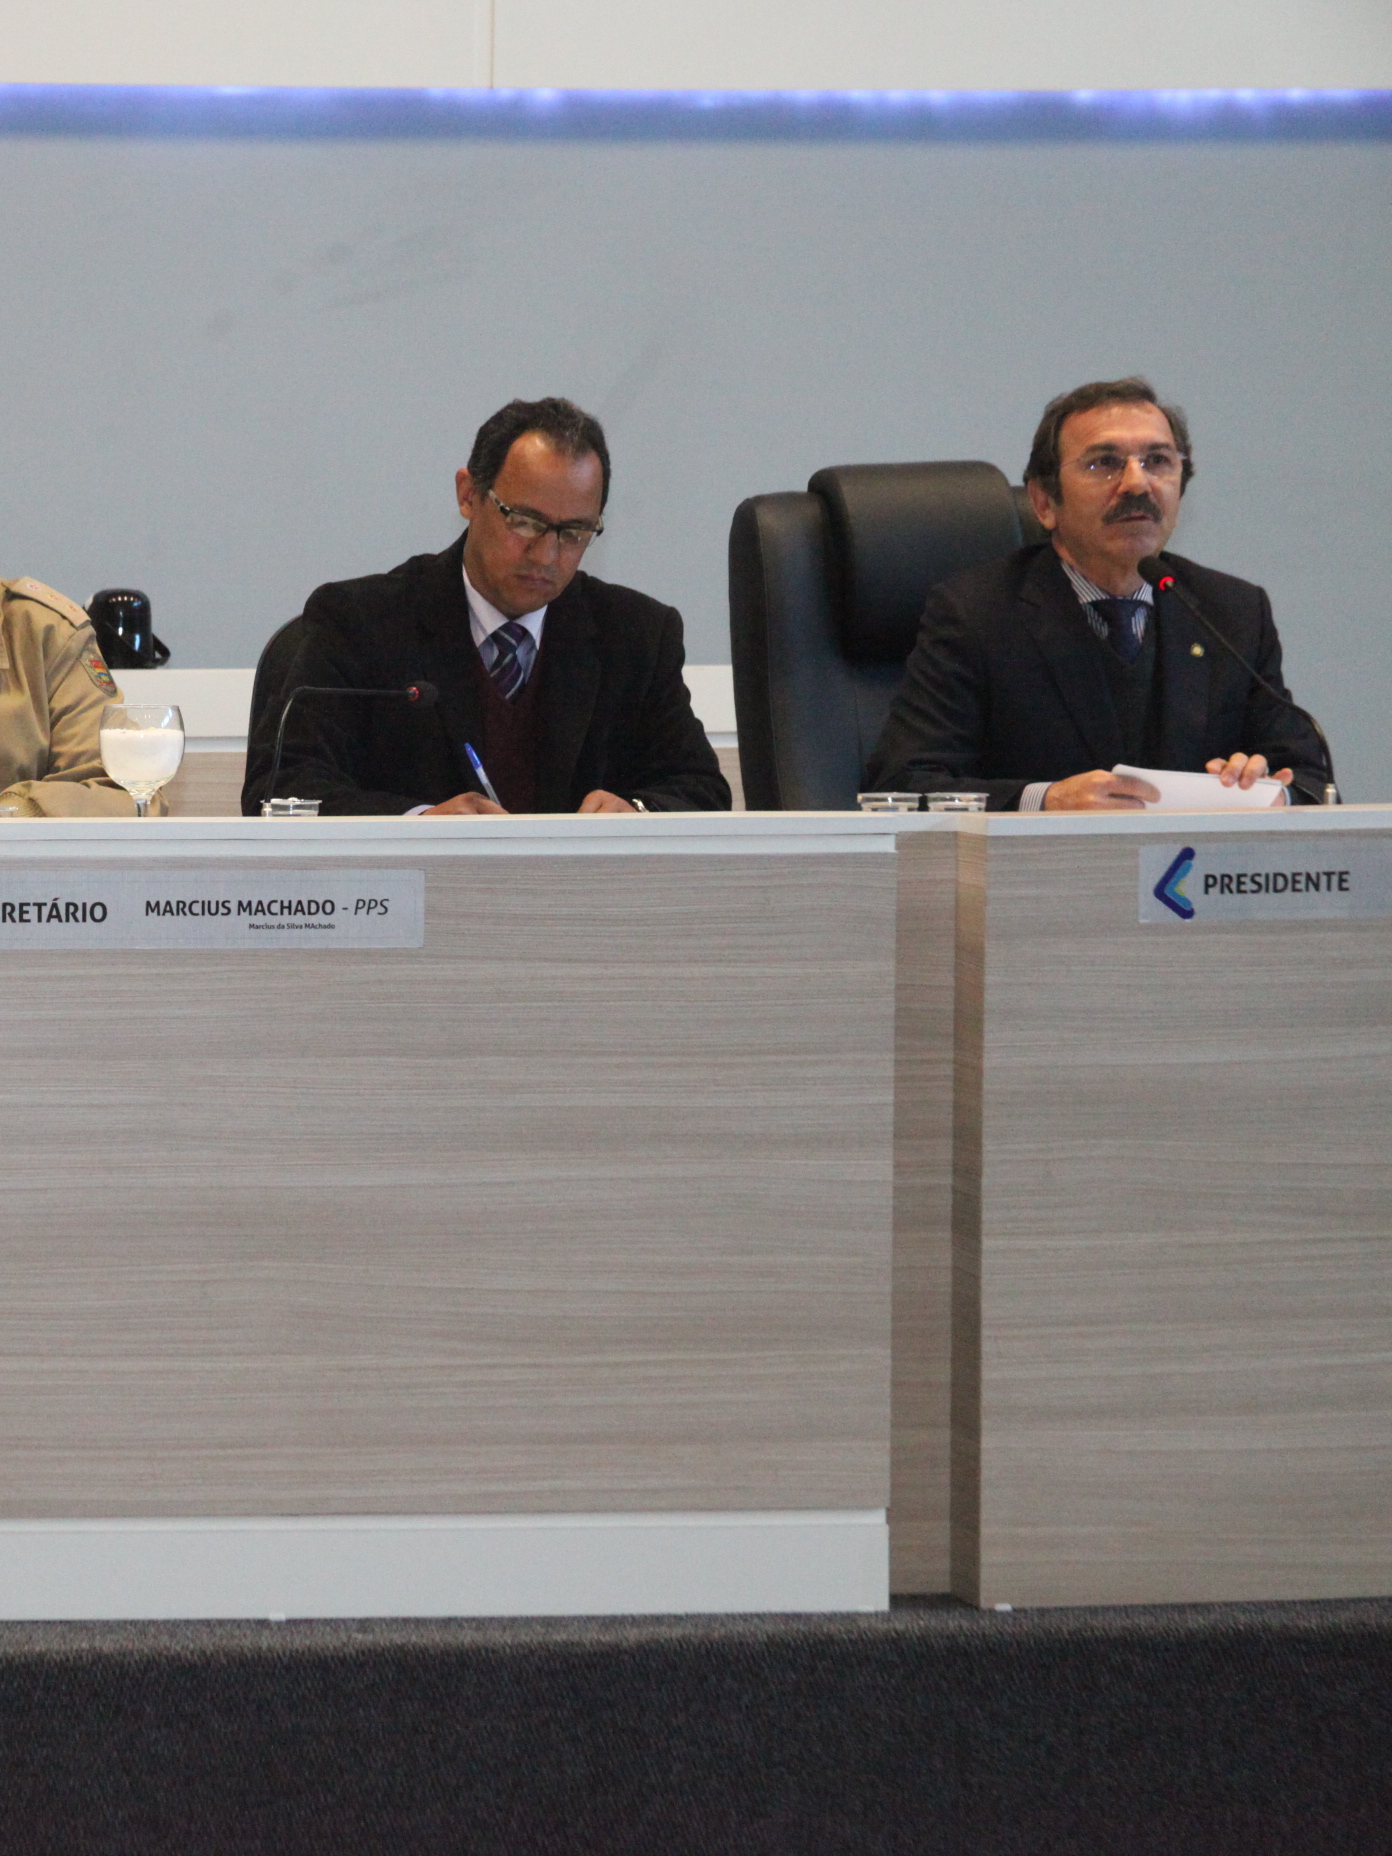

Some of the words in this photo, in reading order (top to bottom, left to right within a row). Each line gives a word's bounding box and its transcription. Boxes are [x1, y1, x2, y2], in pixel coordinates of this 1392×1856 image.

[1203, 870, 1351, 895] PRESIDENTE
[145, 899, 232, 917] MARCIUS
[237, 899, 336, 916] MACHADO
[354, 898, 390, 916] PPS
[248, 922, 276, 930] Marcius
[276, 922, 286, 930] da
[286, 922, 304, 930] Silva
